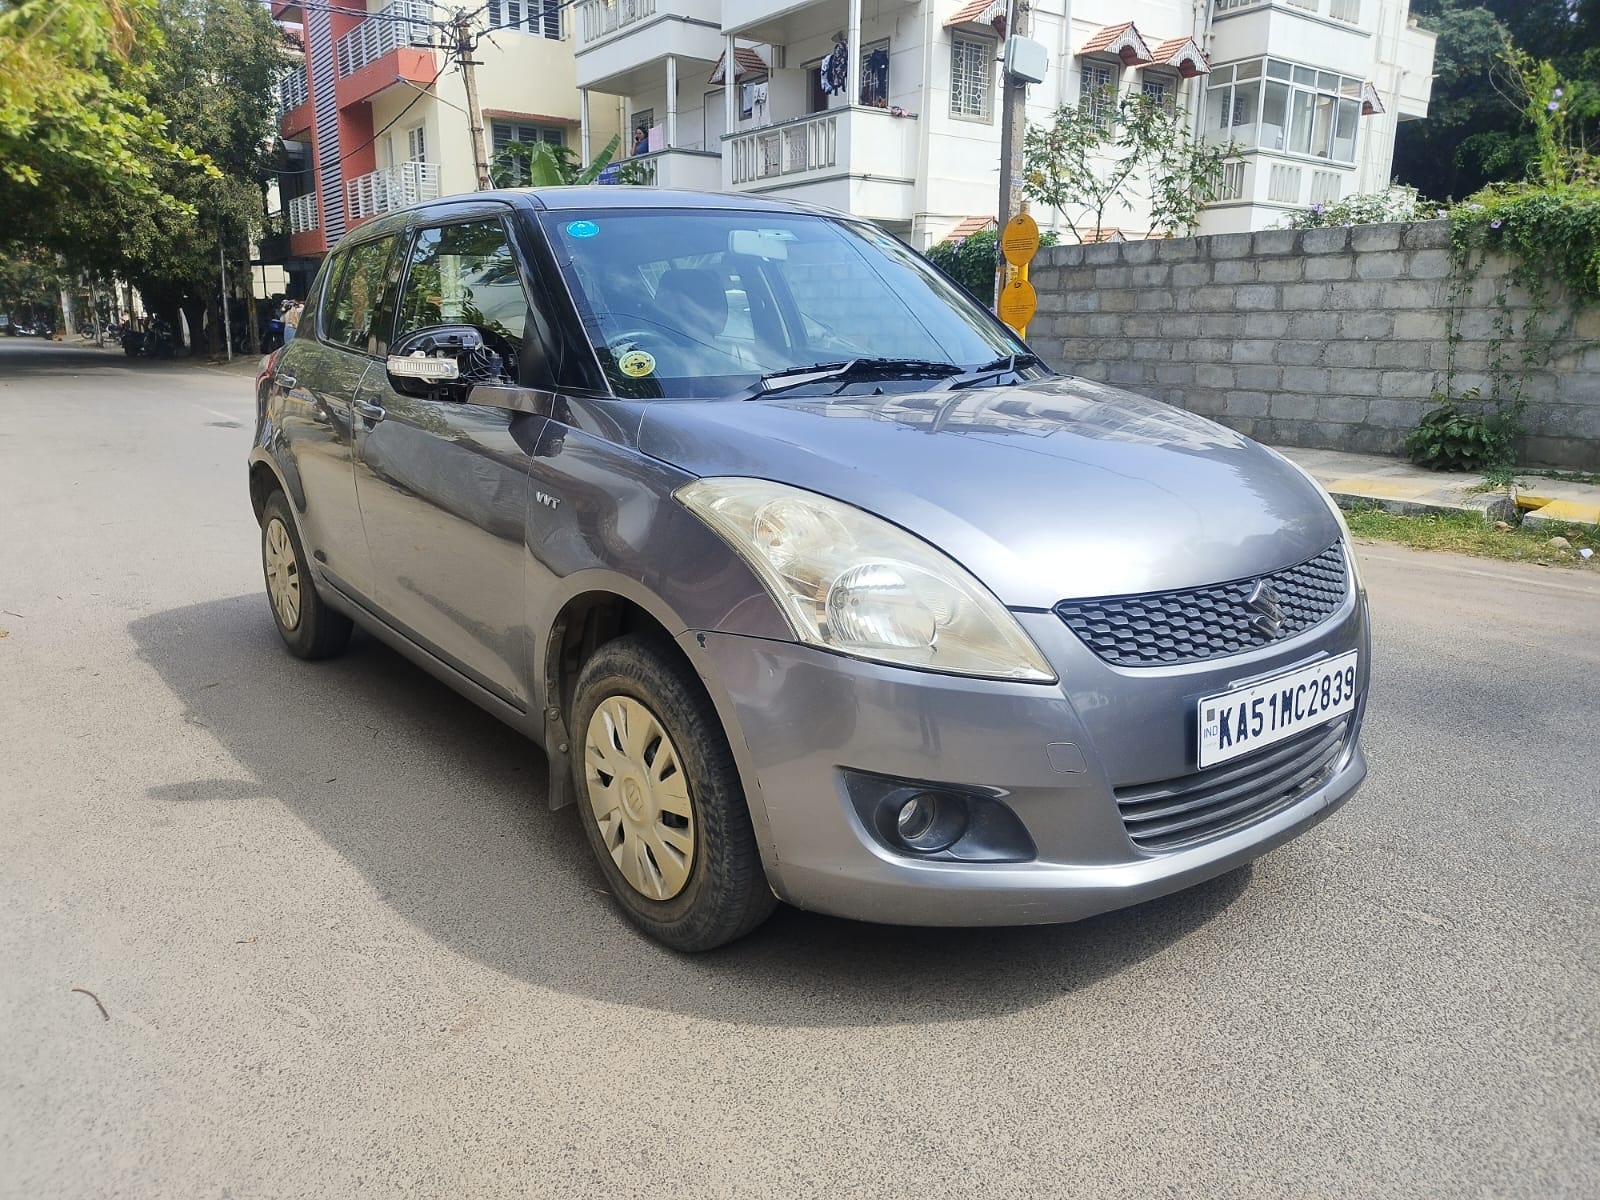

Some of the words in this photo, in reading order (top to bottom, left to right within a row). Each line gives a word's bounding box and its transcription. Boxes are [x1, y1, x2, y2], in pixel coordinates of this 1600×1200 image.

[536, 491, 561, 510] VVT
[1219, 665, 1354, 750] KA51MC2839
[1203, 725, 1218, 739] IND
